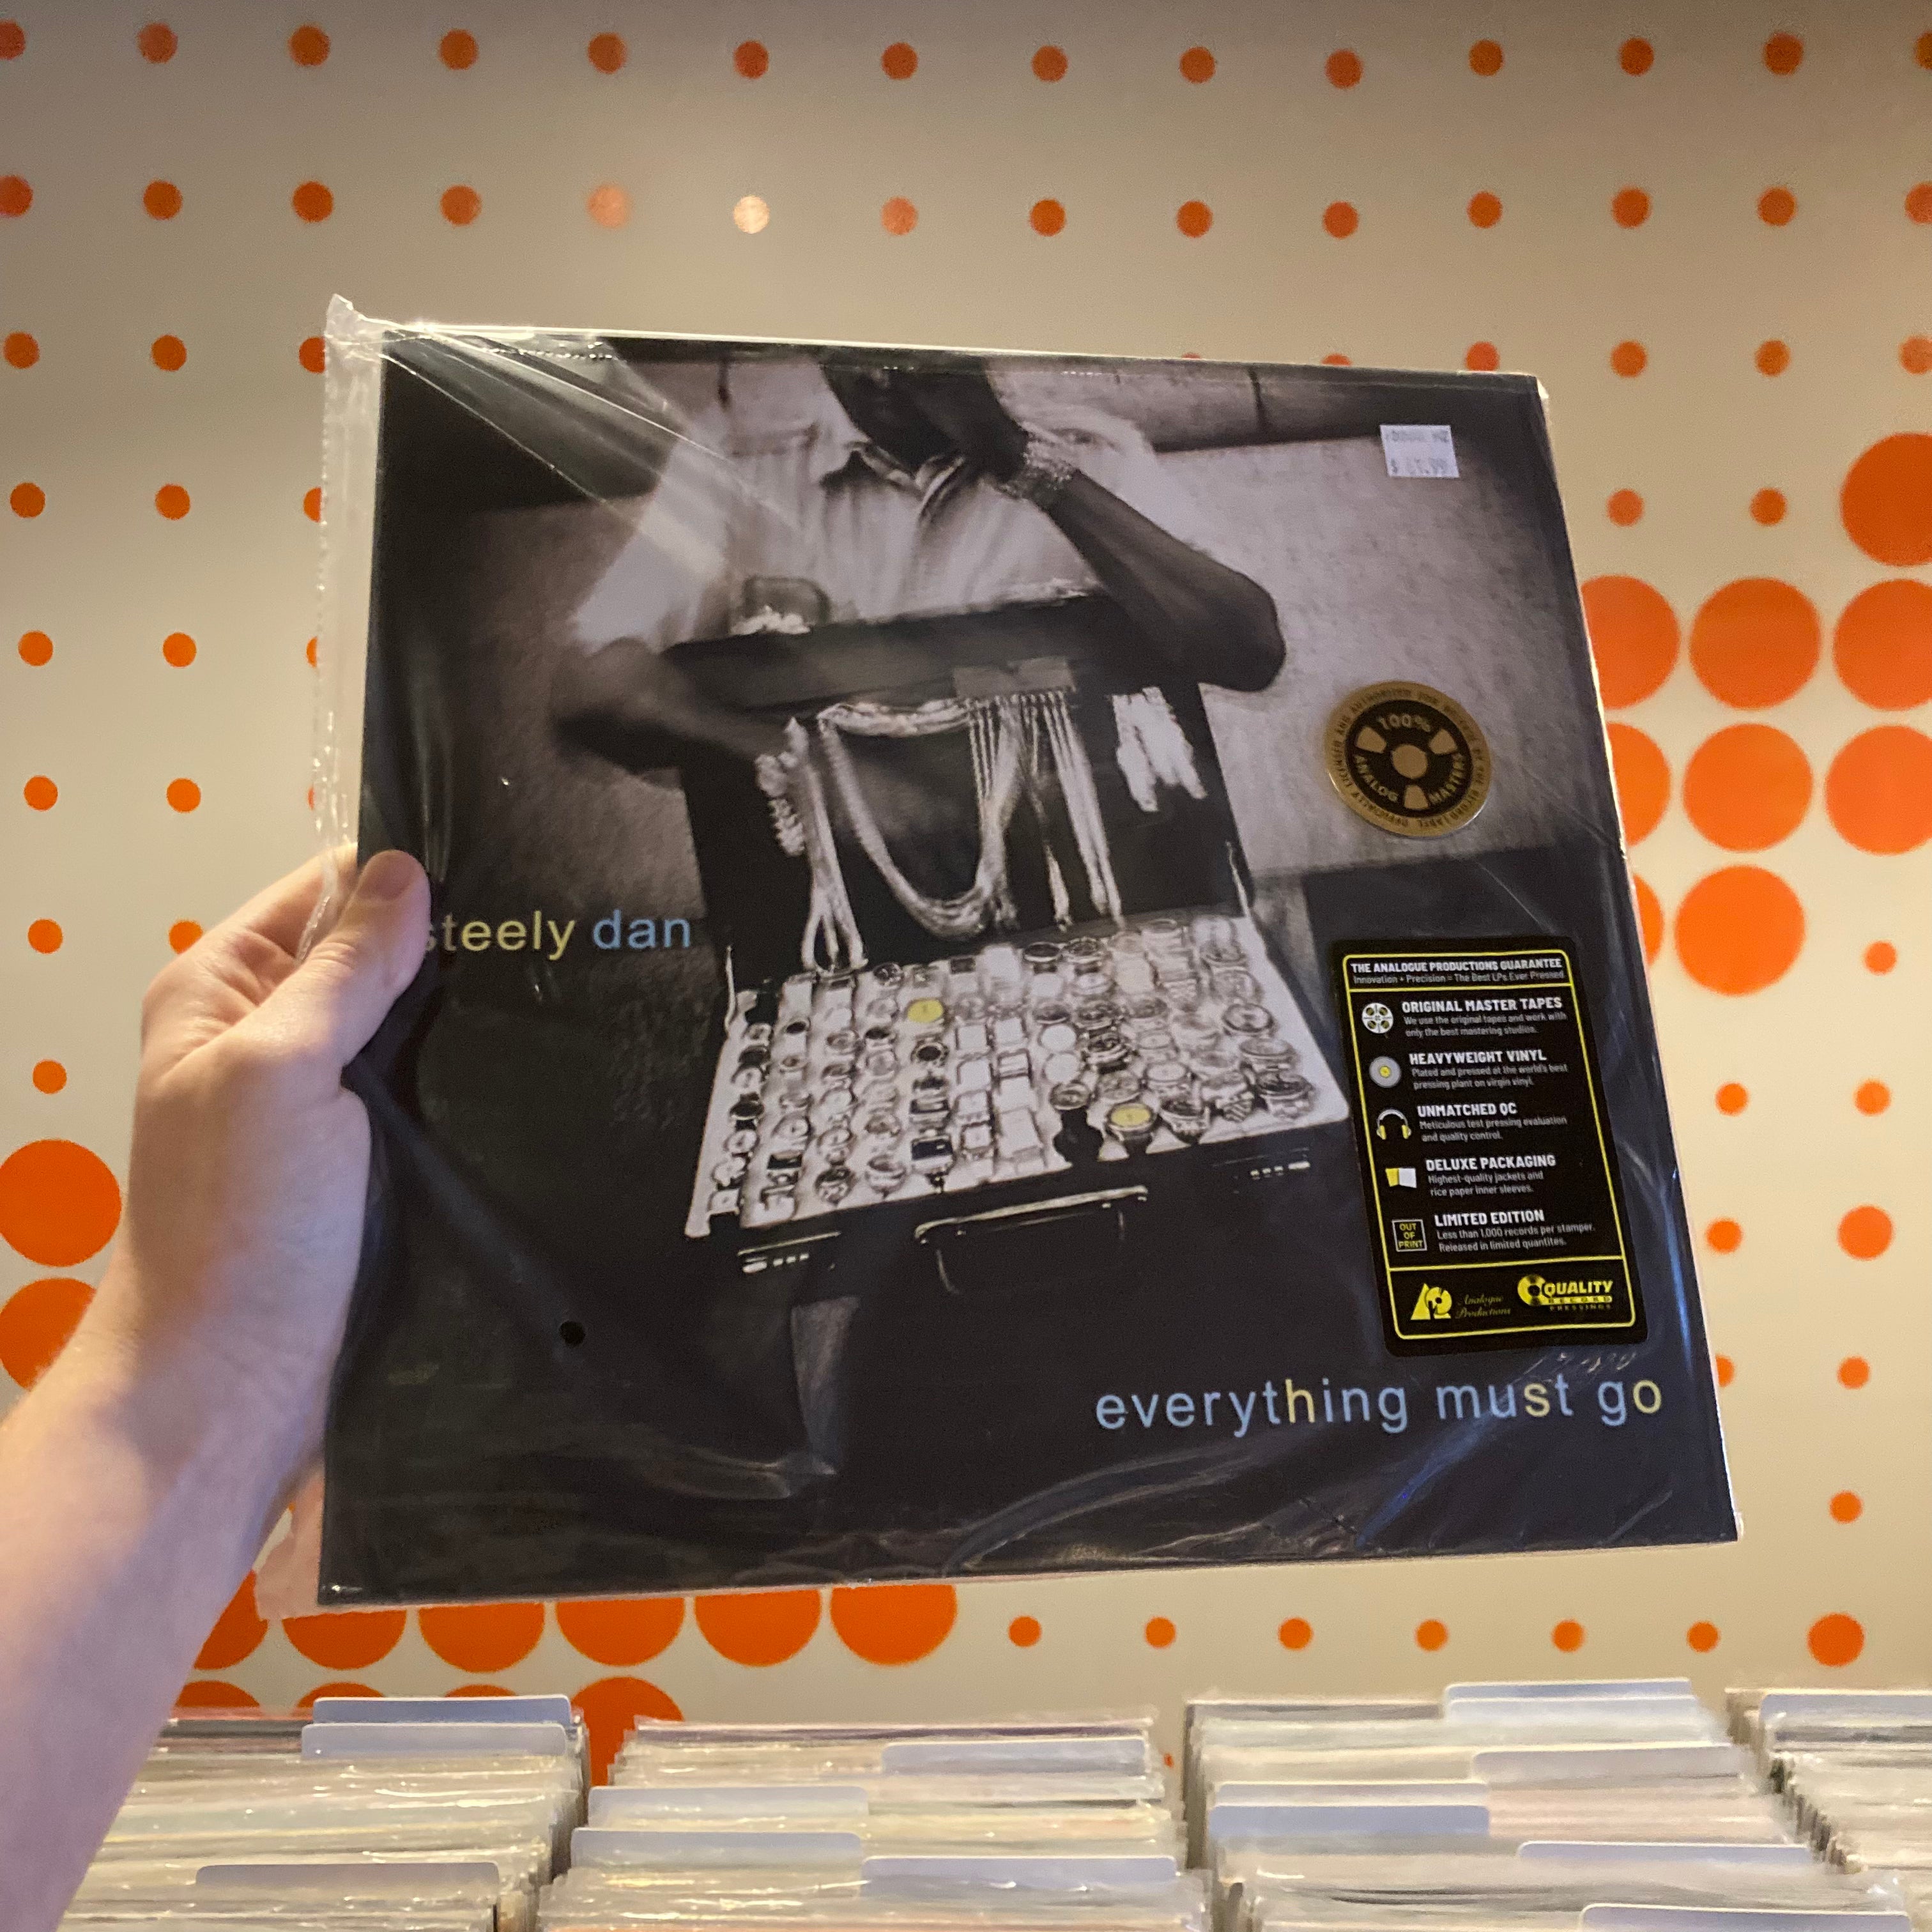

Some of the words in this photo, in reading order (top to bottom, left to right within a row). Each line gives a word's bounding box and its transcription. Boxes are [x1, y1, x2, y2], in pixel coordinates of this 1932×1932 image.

[1377, 712, 1430, 733] 100%
[1354, 754, 1399, 802] ANALOG
[592, 908, 691, 950] dan
[1350, 963, 1371, 973] THE
[1374, 962, 1428, 972] ANALOGUE
[1429, 961, 1498, 971] PRODUCTIONS
[1500, 958, 1562, 970] GUARANTEE
[1354, 974, 1398, 984] Innovation
[1406, 974, 1446, 983] Precision
[1454, 973, 1470, 982] The
[1471, 972, 1490, 982] Best
[1492, 972, 1508, 981] LPs
[1509, 971, 1528, 981] Ever
[1402, 1000, 1462, 1013] ORIGINAL
[1464, 999, 1517, 1011] MASTER
[1520, 997, 1562, 1009] TAPES
[1404, 1016, 1417, 1025] We
[1450, 1015, 1482, 1025] original
[1483, 1015, 1507, 1025] tapes
[1508, 1014, 1524, 1022] and
[1525, 1013, 1547, 1022] work
[1547, 1011, 1567, 1020] with
[1406, 1028, 1423, 1038] only
[1425, 1027, 1439, 1036] the
[1440, 1027, 1459, 1036] best
[1460, 1026, 1503, 1036] mastering
[1409, 1051, 1503, 1064] HEAVYWEIGHT
[1506, 1049, 1547, 1062] VINYL
[1411, 1068, 1438, 1077] Plated
[1441, 1068, 1456, 1076] and
[1457, 1066, 1491, 1077] pressed
[1503, 1066, 1517, 1074] the
[1548, 1064, 1568, 1073] best
[1413, 1080, 1450, 1091] pressing
[1451, 1080, 1473, 1090] plant
[1486, 1078, 1511, 1089] virgin
[1417, 1103, 1497, 1117] UNMATCHED
[1499, 1102, 1518, 1116] QC
[1419, 1119, 1466, 1130] Meticulous
[1466, 1119, 1484, 1128] test
[1485, 1118, 1522, 1128] pressing
[1523, 1116, 1567, 1126] evaluation
[1422, 1131, 1438, 1142] and
[1439, 1131, 1468, 1143] quality
[1425, 1157, 1478, 1171] DELUXE
[1480, 1154, 1556, 1169] PACKAGING
[1428, 1172, 1493, 1186] Highest-quality
[1494, 1171, 1526, 1183] jackets
[1527, 1170, 1544, 1180] and
[1430, 1188, 1447, 1197] rice
[1449, 1186, 1473, 1198] paper
[1475, 1184, 1499, 1195] inner
[1499, 1183, 1534, 1193] sleeves.
[1434, 1213, 1488, 1227] LIMITED
[1490, 1209, 1545, 1225] EDITION
[1399, 1222, 1416, 1232] OUT
[1437, 1229, 1458, 1240] Less
[1459, 1229, 1479, 1239] than
[1504, 1225, 1539, 1237] records
[1540, 1225, 1554, 1236] per
[1557, 1223, 1596, 1235] stamper.
[1403, 1231, 1416, 1240] OF
[1398, 1239, 1423, 1249] PRINT
[1438, 1241, 1478, 1252] Released
[1480, 1241, 1489, 1250] in
[1489, 1238, 1521, 1250] limited
[1544, 1280, 1613, 1298] QUALITY
[1096, 1377, 1407, 1438] everything
[1436, 1372, 1574, 1420] must
[1597, 1378, 1662, 1427] go
